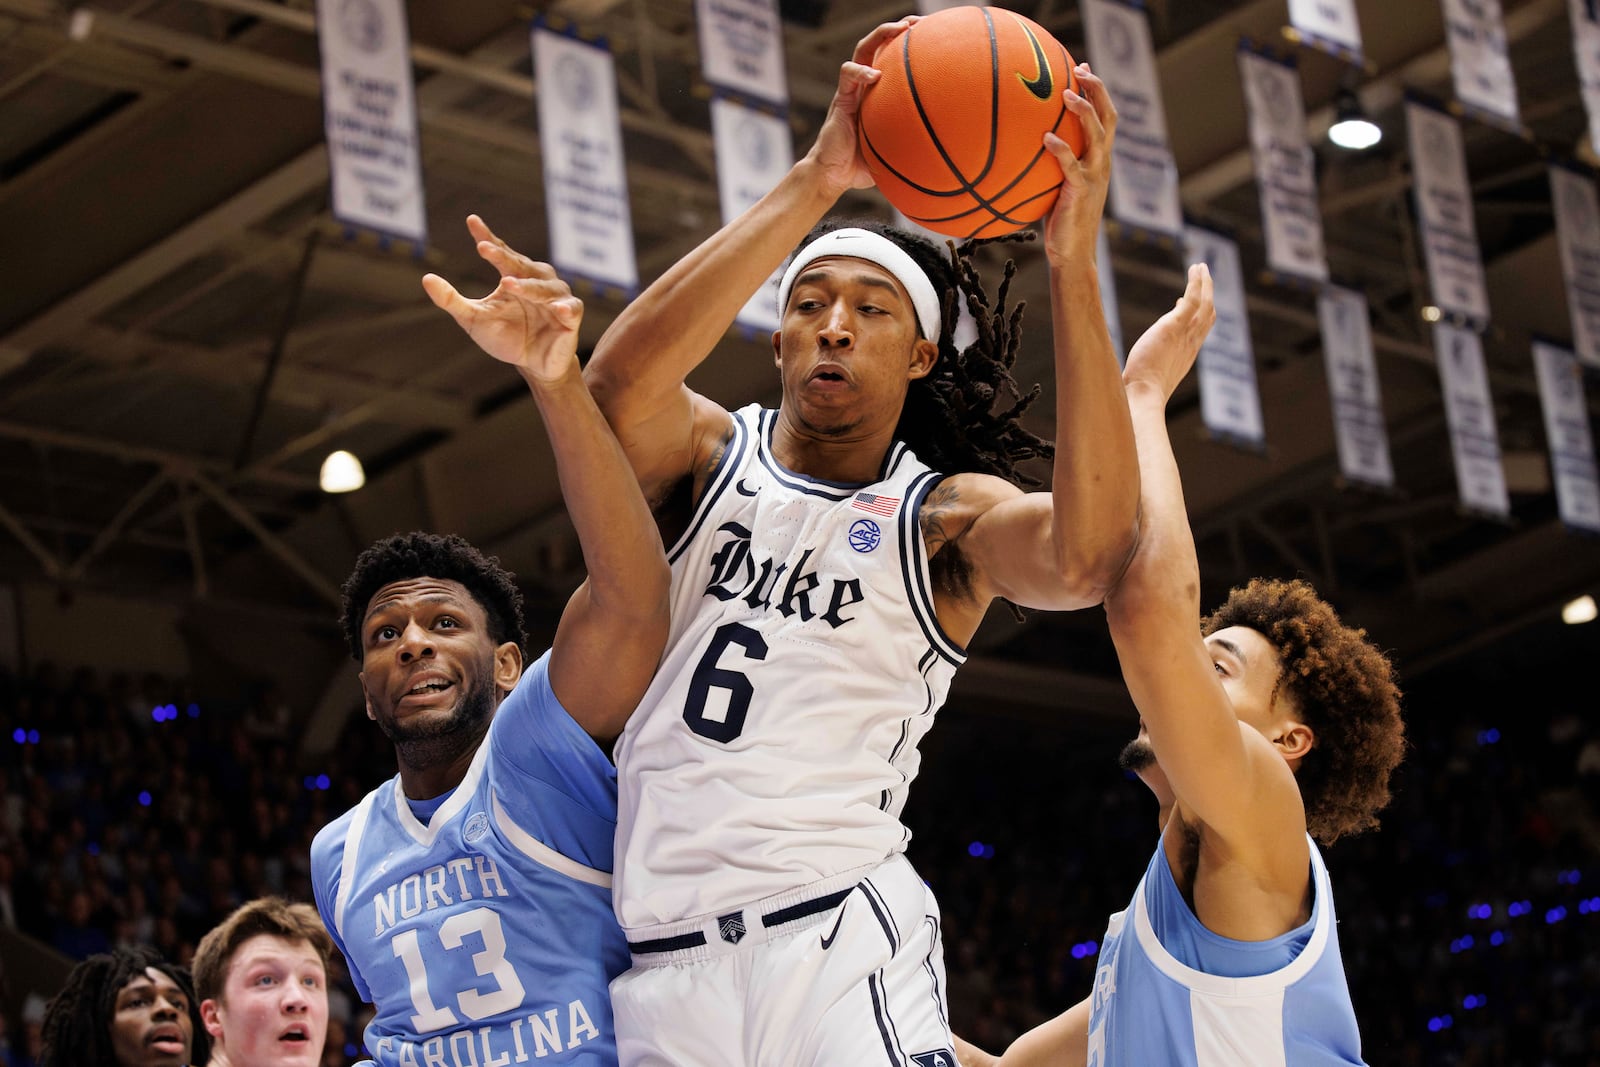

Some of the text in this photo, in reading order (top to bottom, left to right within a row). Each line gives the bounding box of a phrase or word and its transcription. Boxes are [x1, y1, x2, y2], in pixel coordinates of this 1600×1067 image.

[703, 521, 864, 629] Duke
[683, 622, 769, 744] 6
[373, 856, 508, 937] NORTH
[391, 907, 526, 1034] 13
[376, 999, 600, 1067] CAROLINA
